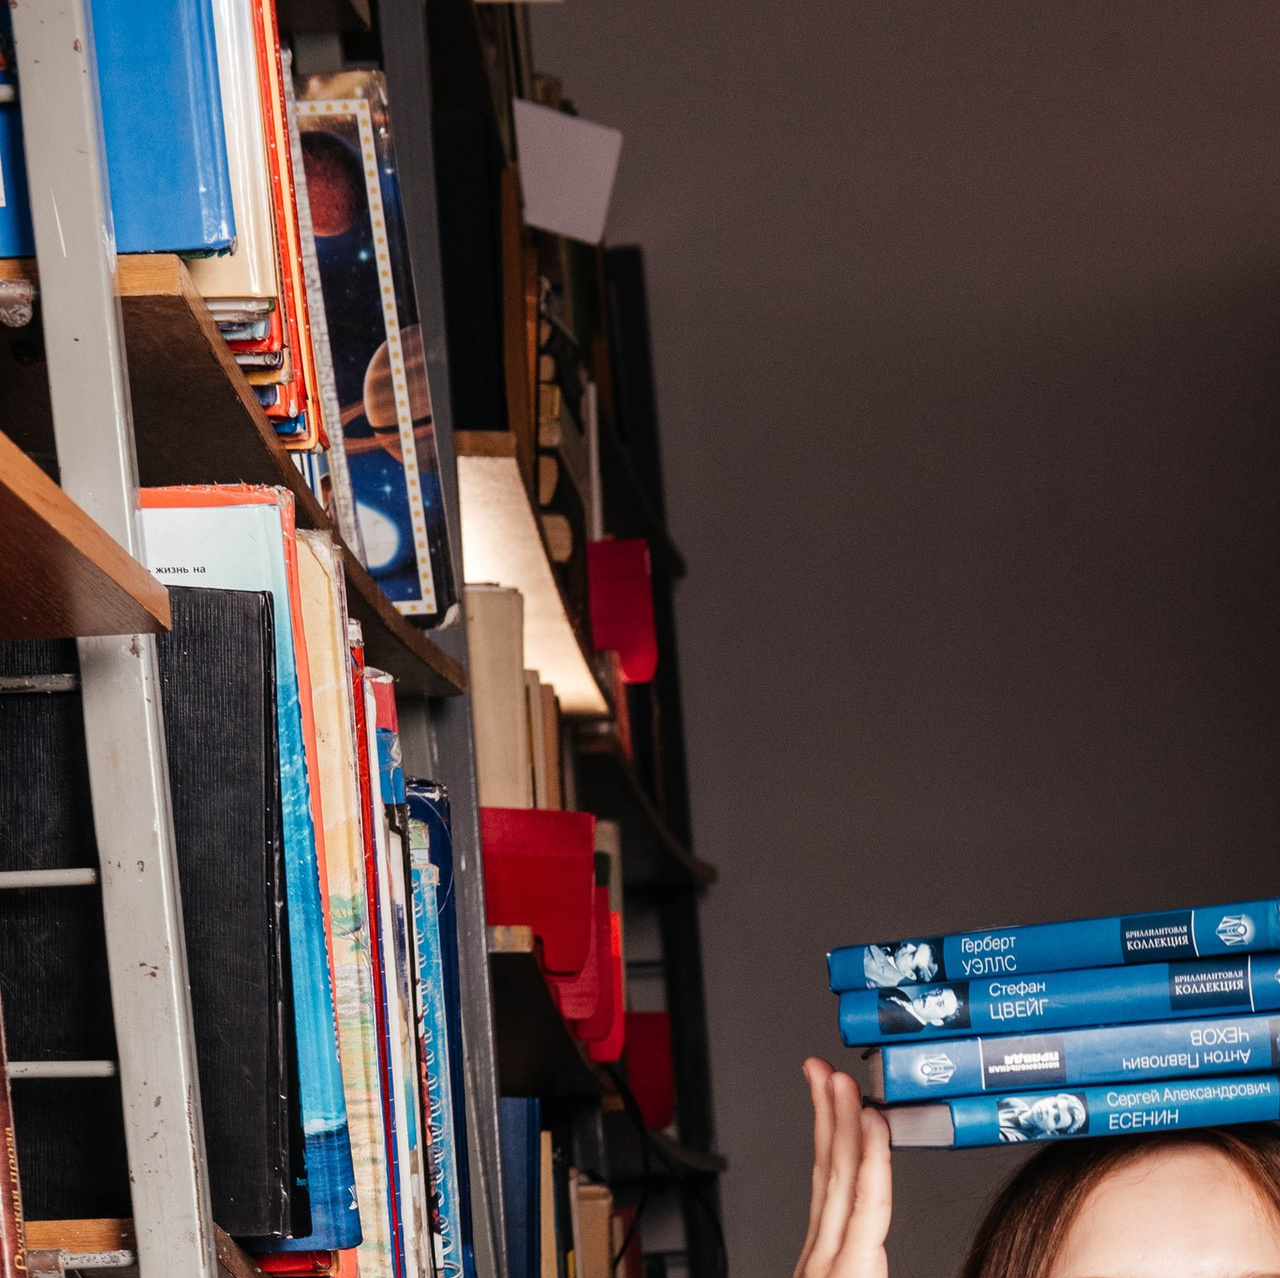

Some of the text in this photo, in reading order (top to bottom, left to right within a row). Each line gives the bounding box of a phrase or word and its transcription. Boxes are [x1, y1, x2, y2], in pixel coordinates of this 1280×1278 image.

[1125, 925, 1188, 939] БРИЛЛИАНТОВАЯ
[961, 935, 1016, 953] Герберт
[1126, 935, 1189, 951] КОЛЛЕКЦИЯ
[961, 955, 1017, 976] УЭЛЛС
[1174, 970, 1243, 984] БРИЛЛИАНТОВАЯ
[989, 981, 1046, 997] Стефан
[1175, 981, 1244, 996] КОЛЛЕКЦИЯ
[989, 998, 1049, 1020] ЦВЕЙГ
[1190, 1027, 1250, 1047] ЧЕХОВ
[1003, 1051, 1060, 1066] ПРАВДА
[1122, 1048, 1251, 1070] Антон Павлович
[1107, 1081, 1271, 1108] Сергей Александрович
[1108, 1109, 1179, 1130] ЕСЕНИН
[5, 1127, 27, 1270] Русская проза
